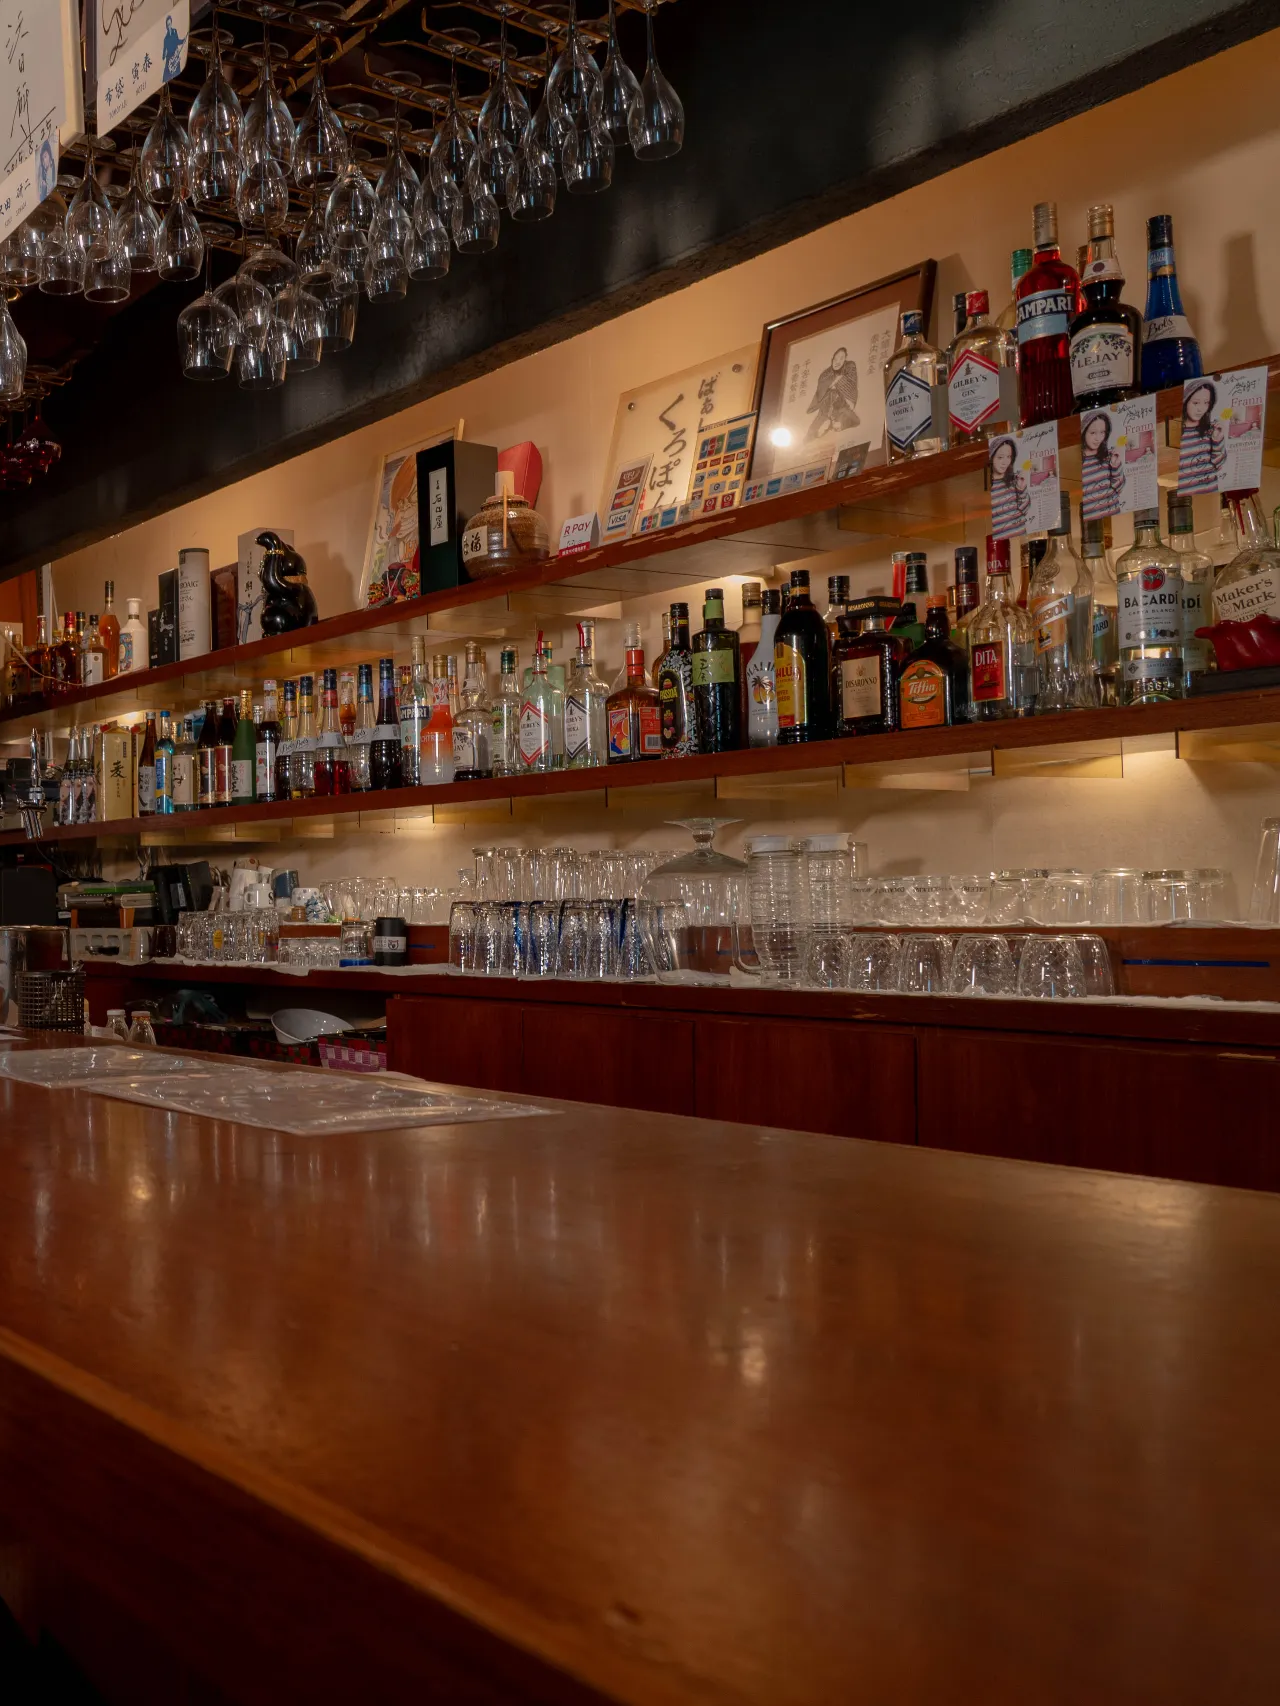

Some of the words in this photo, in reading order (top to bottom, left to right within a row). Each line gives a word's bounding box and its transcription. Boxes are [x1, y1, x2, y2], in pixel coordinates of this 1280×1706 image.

[1017, 295, 1073, 322] AMPARI
[1077, 351, 1121, 369] LEJAY
[952, 374, 988, 390] GILBEY'S
[888, 392, 920, 408] GILBEY'S
[1124, 590, 1179, 609] BACARDÍ
[1215, 578, 1273, 606] Maker's
[1231, 590, 1277, 613] Mark
[975, 649, 998, 667] DITA
[746, 661, 775, 678] MALI
[845, 676, 878, 689] DISARONNO
[908, 680, 937, 697] Tiffin
[110, 759, 127, 779] 麦
